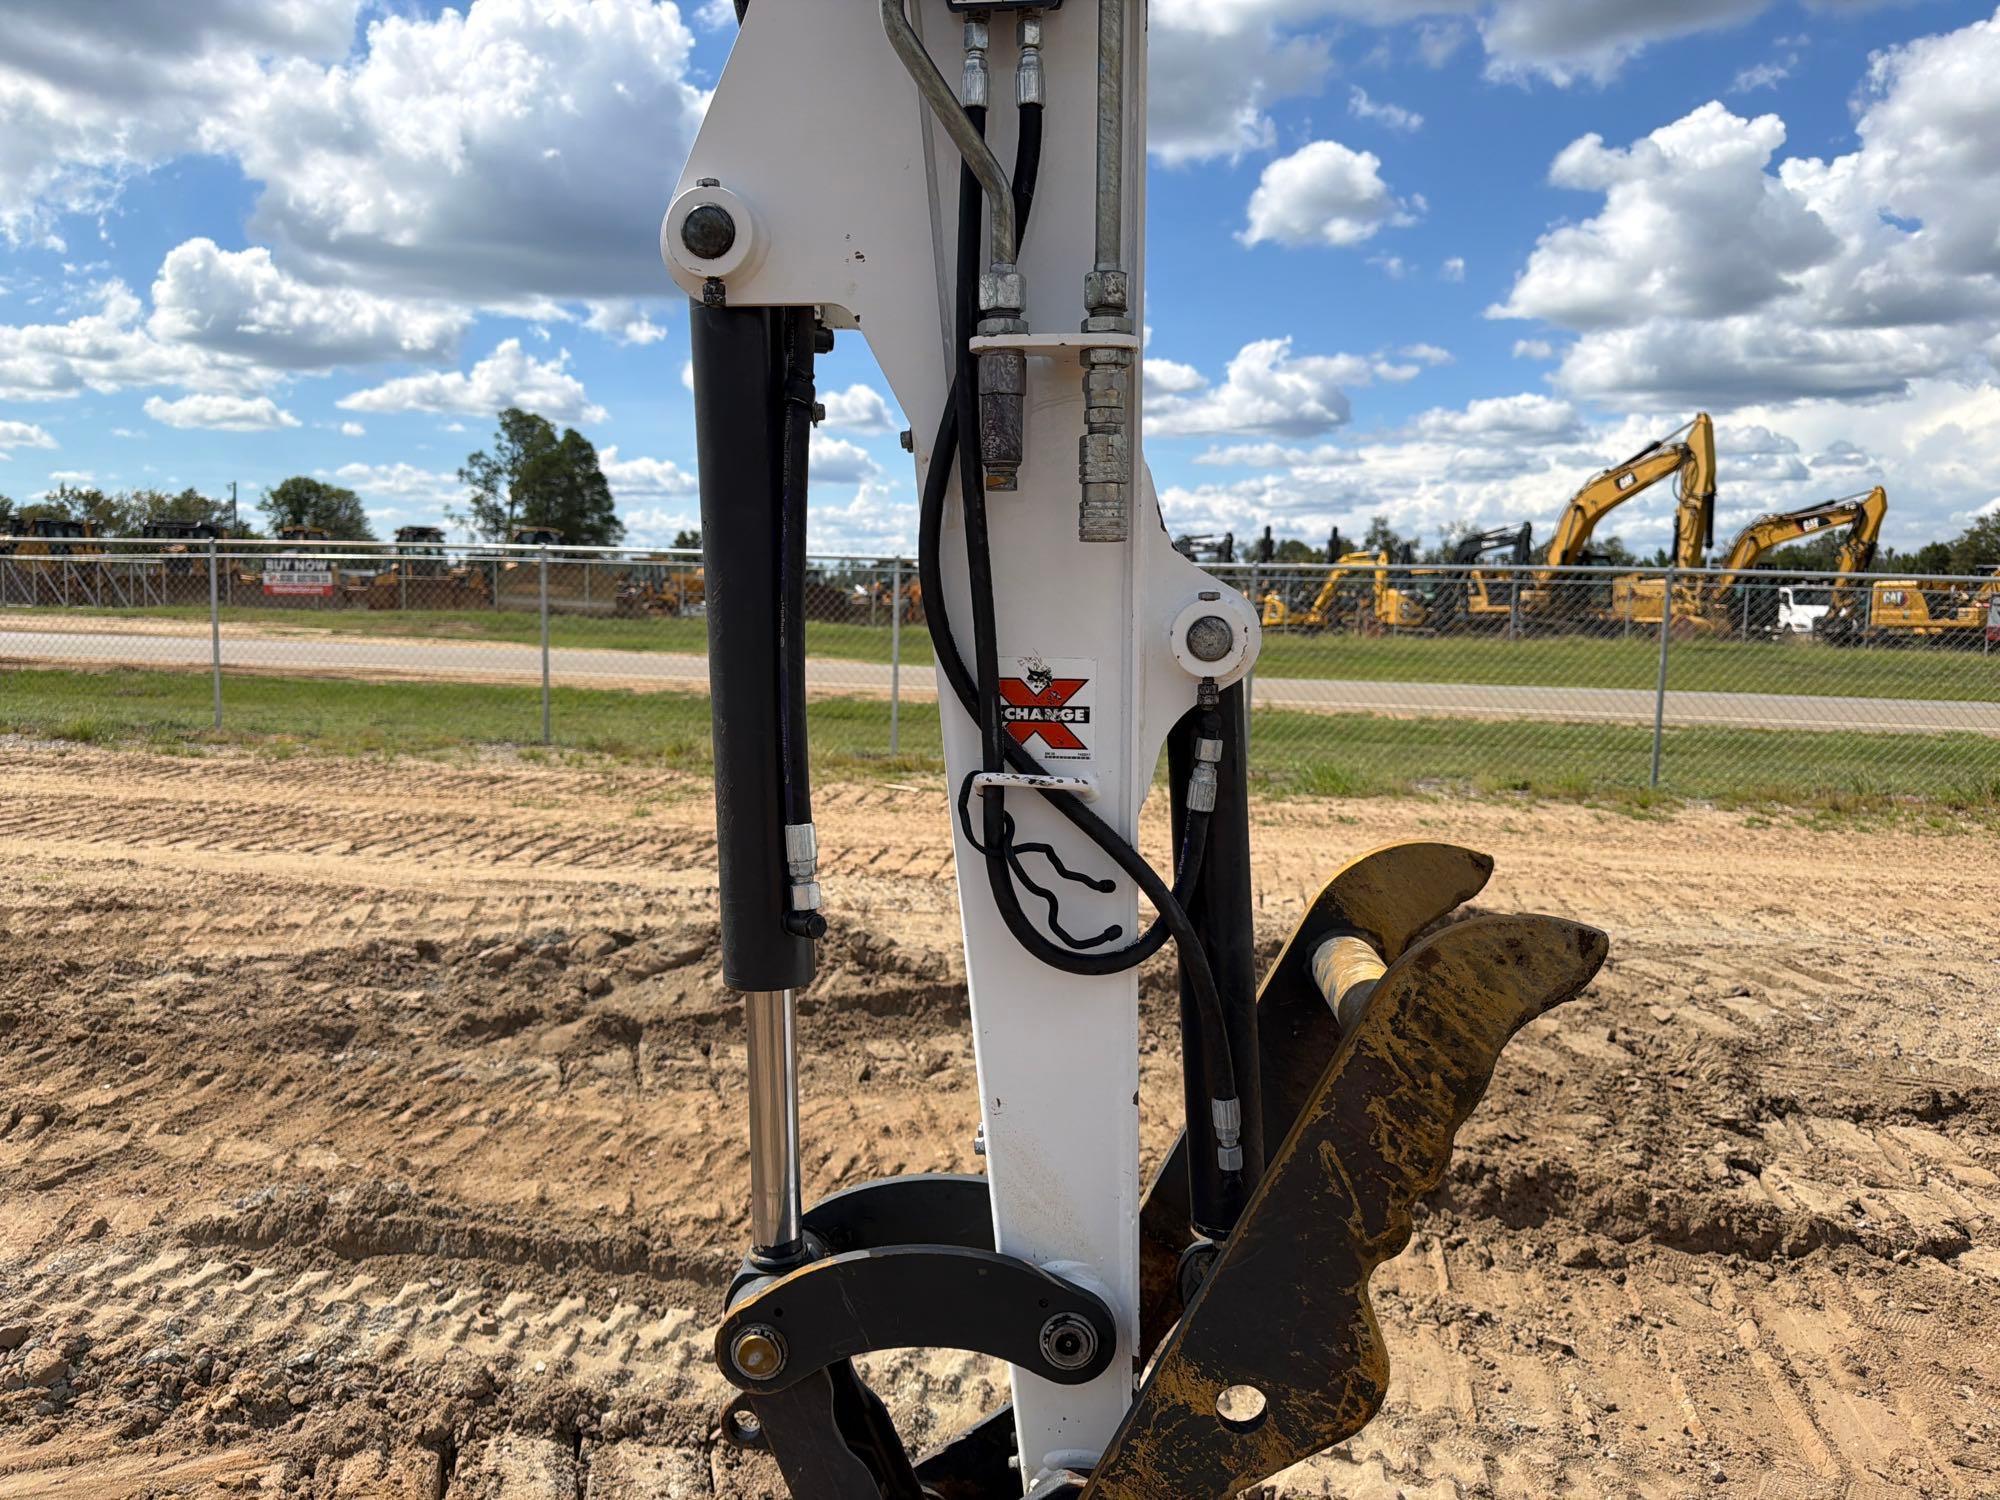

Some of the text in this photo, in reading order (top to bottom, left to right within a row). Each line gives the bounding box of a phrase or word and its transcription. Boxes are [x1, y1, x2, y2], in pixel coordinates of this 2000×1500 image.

[1619, 474, 1634, 489] CAT
[1803, 518, 1818, 532] CAT
[266, 559, 326, 571] BUY NOW
[1883, 592, 1902, 605] CAT
[1001, 708, 1086, 722] CHANGE
